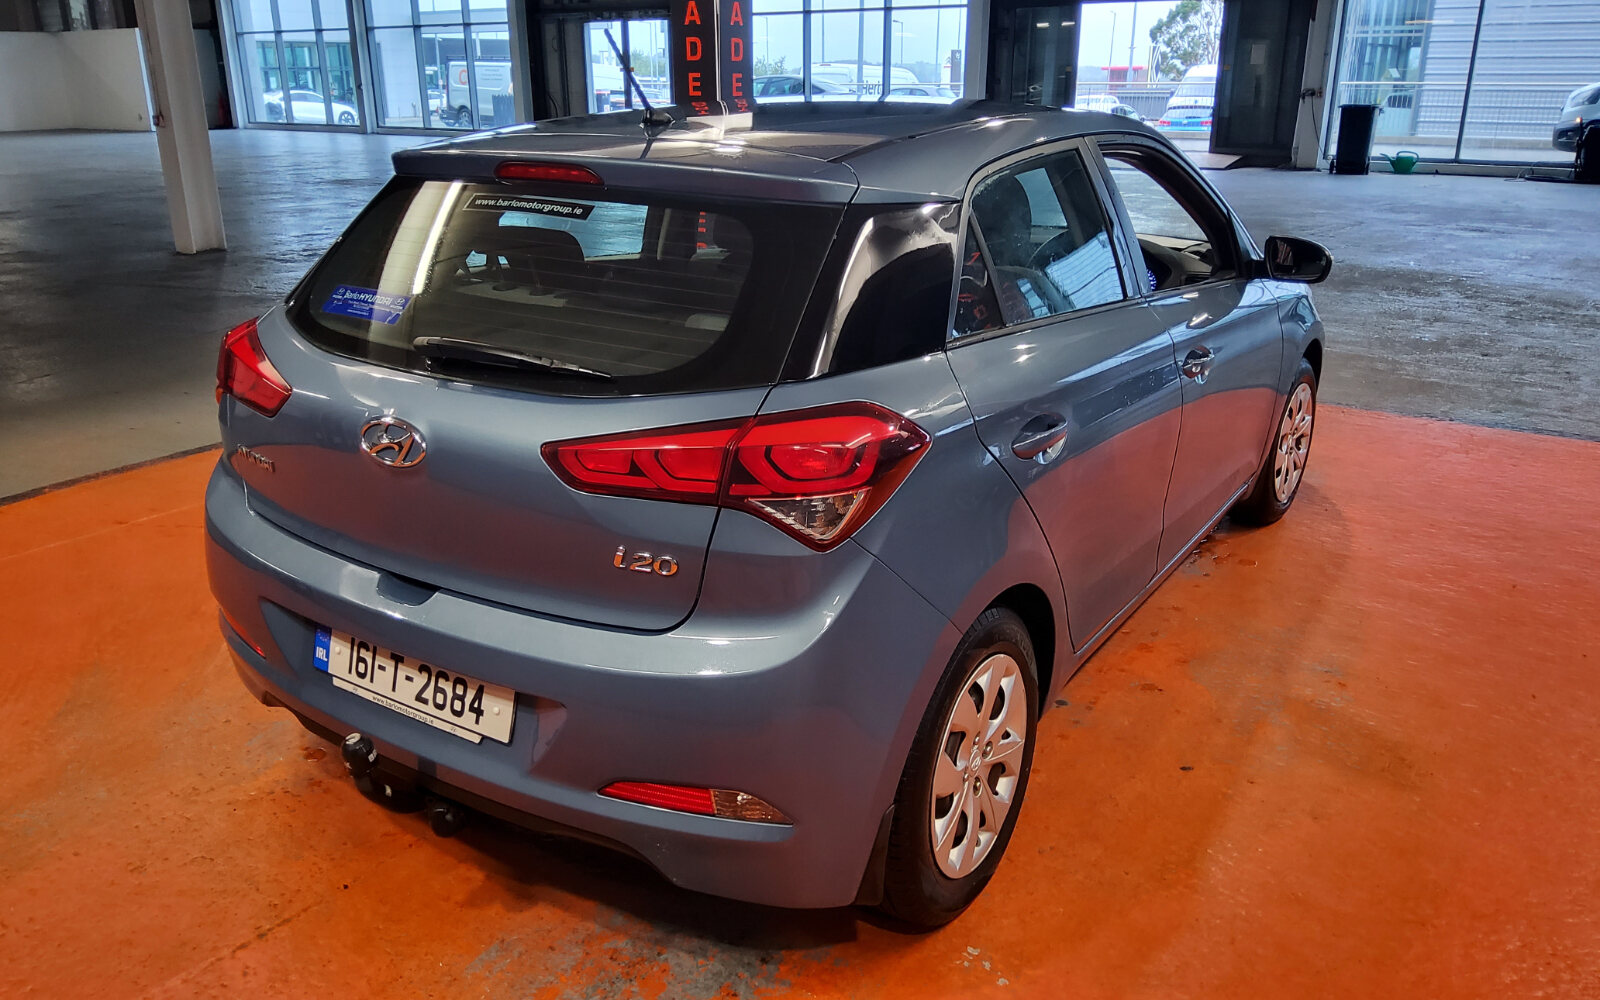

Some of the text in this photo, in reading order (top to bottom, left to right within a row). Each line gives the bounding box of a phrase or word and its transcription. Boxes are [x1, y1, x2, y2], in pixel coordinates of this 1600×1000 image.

[475, 198, 583, 215] www.barlomotorgroup.ie
[613, 545, 679, 576] i20
[315, 646, 328, 662] IRL
[348, 636, 485, 725] 161-T-2684
